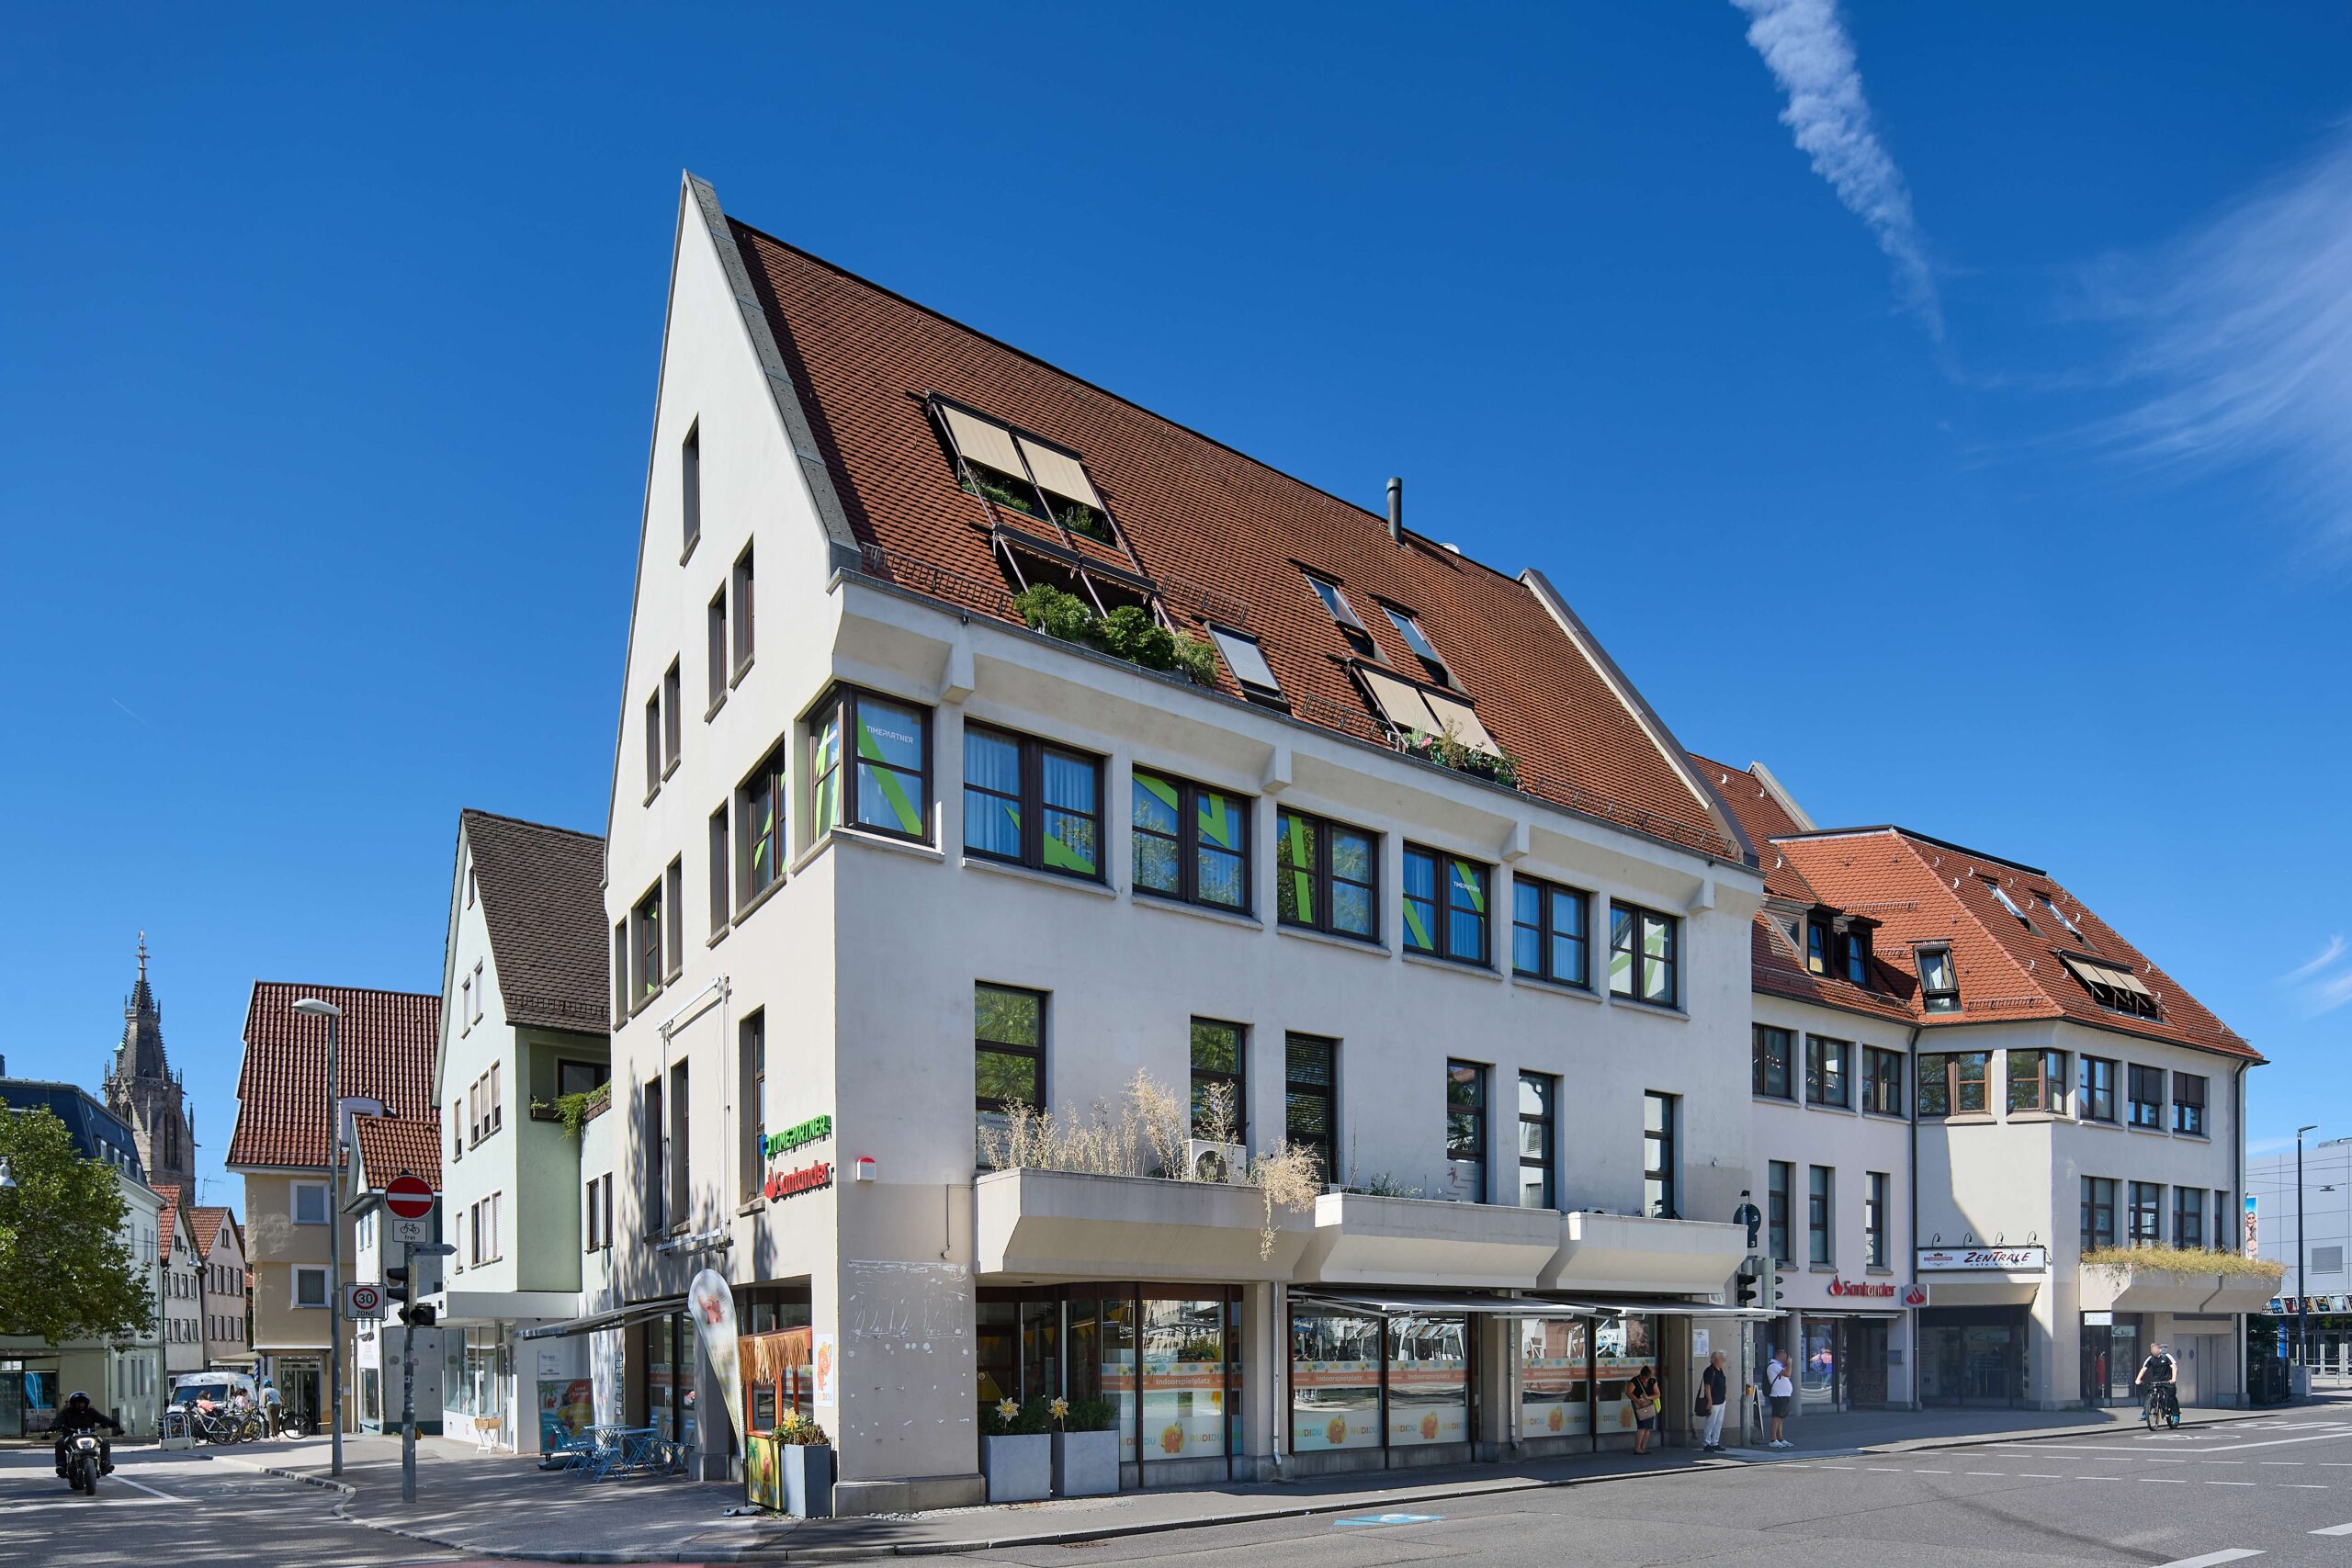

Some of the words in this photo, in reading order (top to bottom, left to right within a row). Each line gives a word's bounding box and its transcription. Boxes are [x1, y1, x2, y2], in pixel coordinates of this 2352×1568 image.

[866, 726, 913, 744] TIMEPARTNER
[774, 1115, 831, 1151] TIMEPARTNER
[776, 1160, 830, 1196] Santander
[1844, 1280, 1895, 1297] Santander
[358, 1293, 373, 1304] 30
[1156, 1378, 1210, 1389] Indoorspielplatz
[1316, 1374, 1363, 1382] Indoorspielplatz
